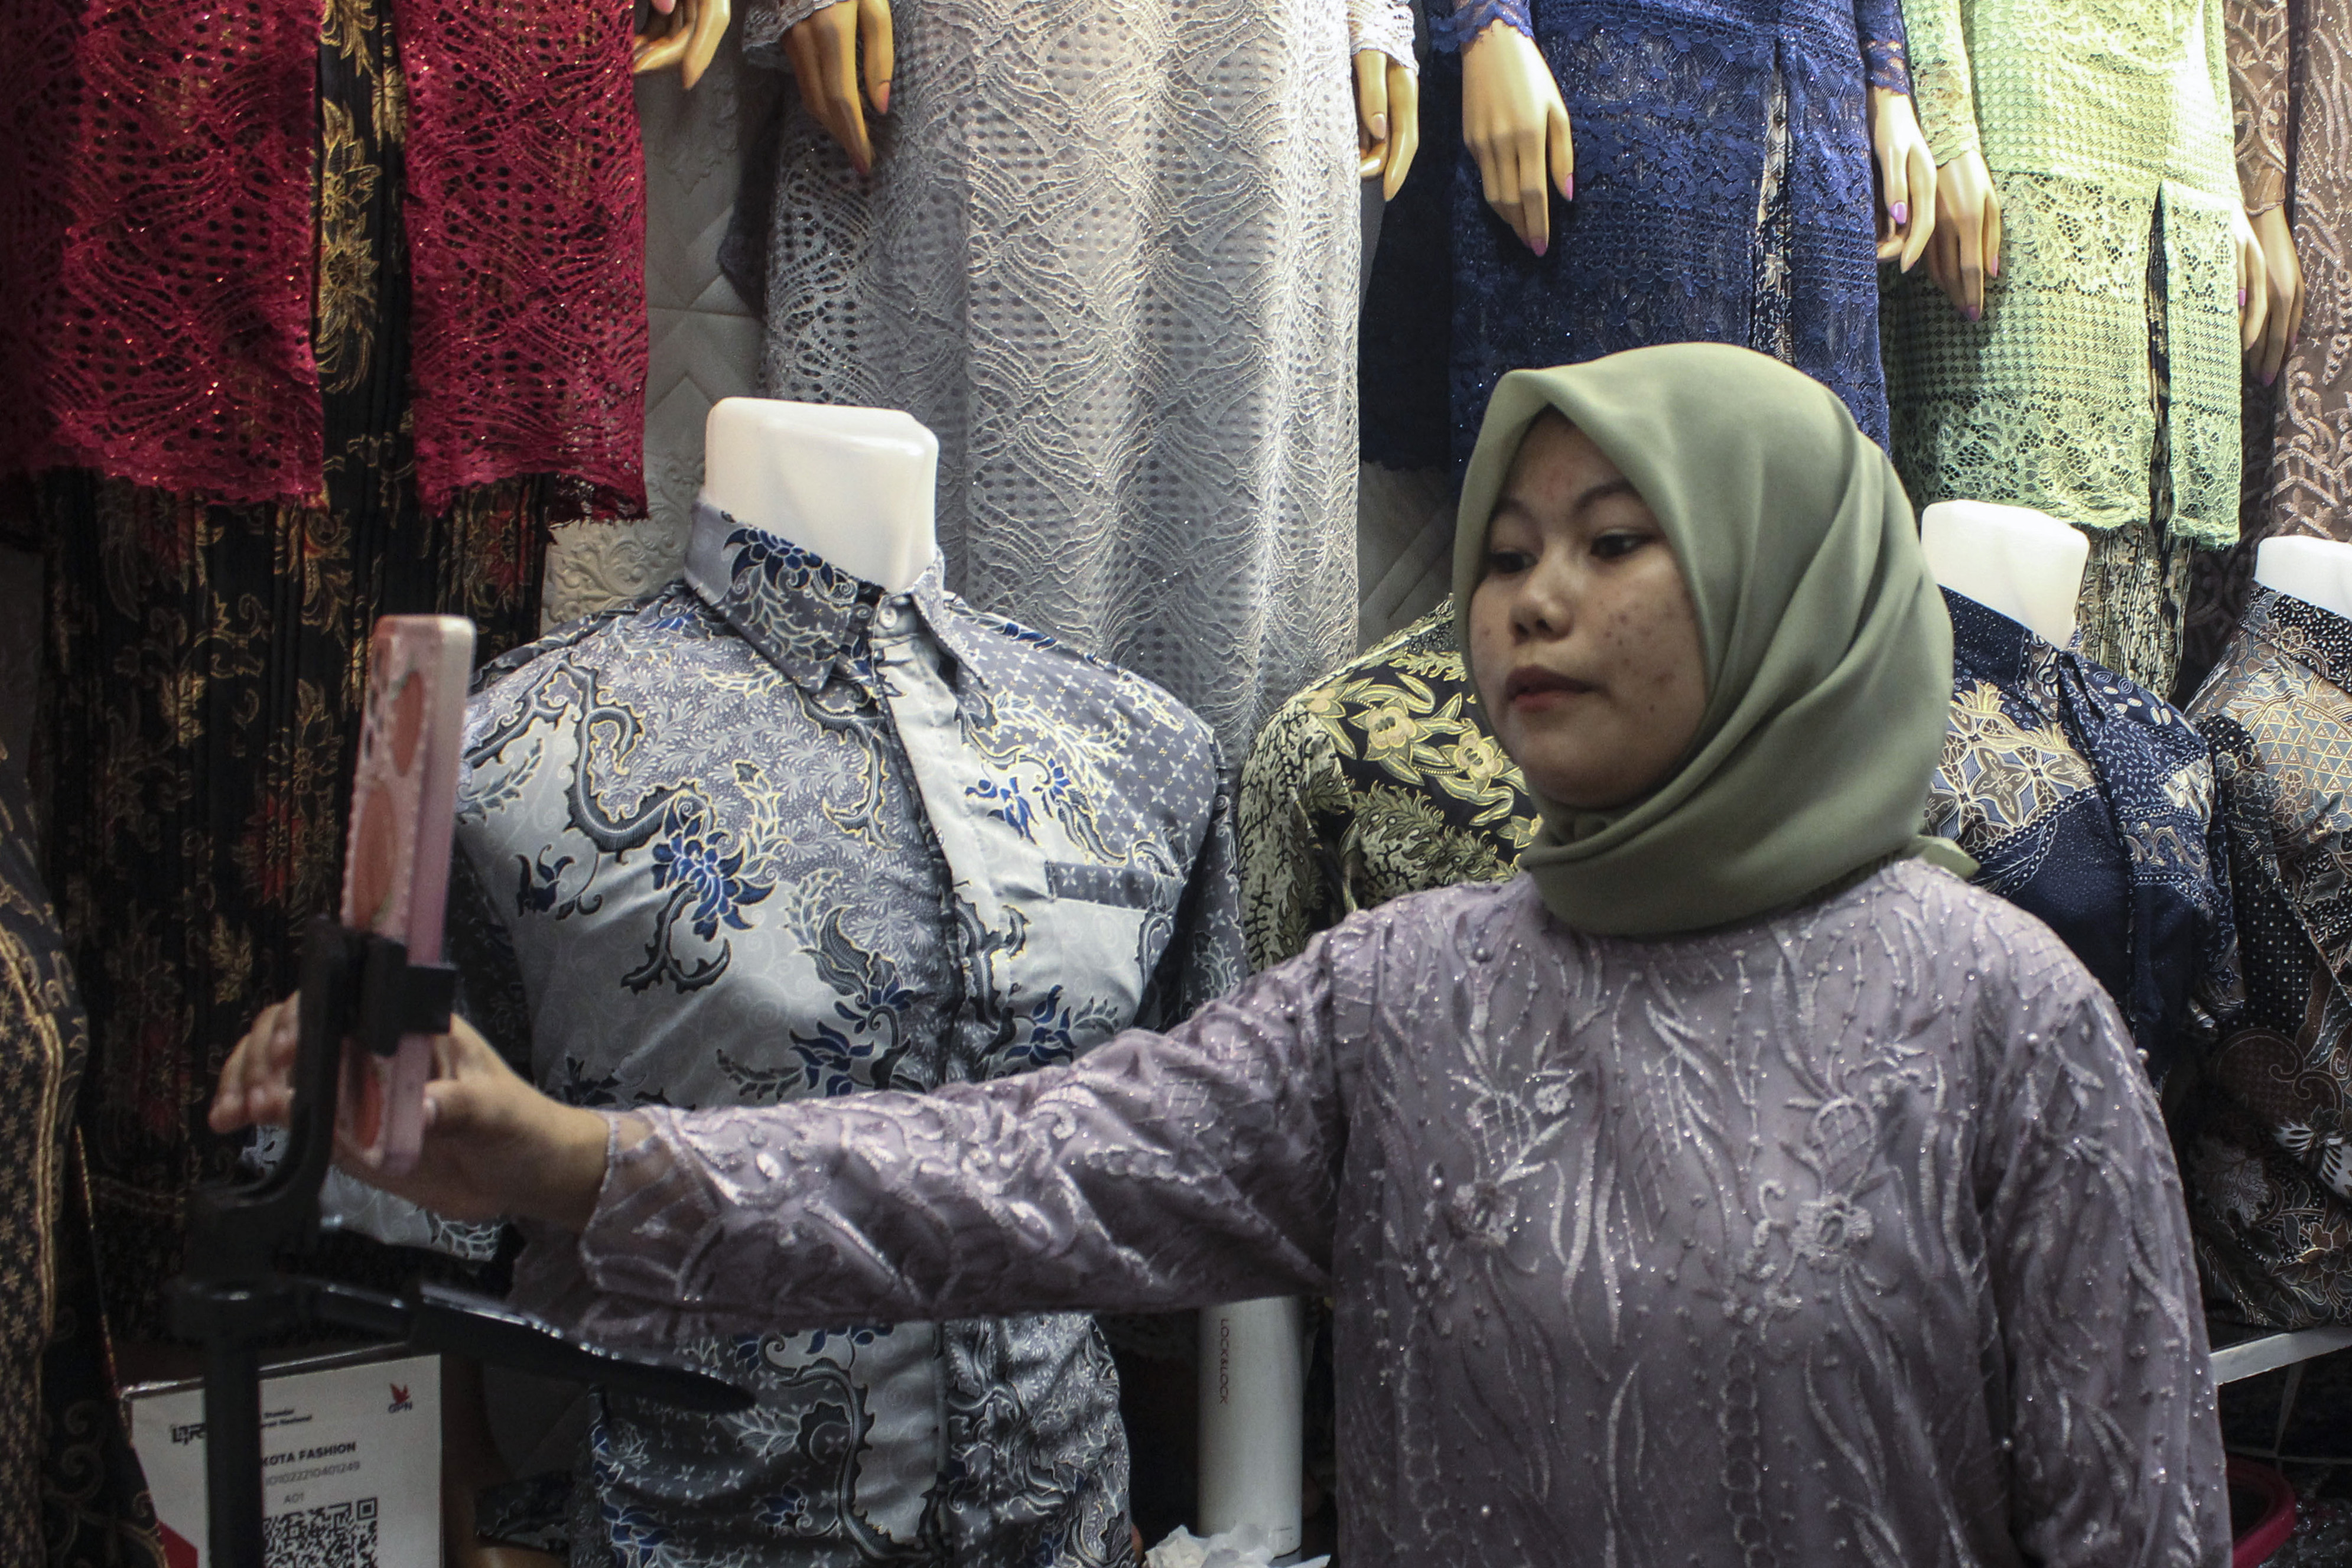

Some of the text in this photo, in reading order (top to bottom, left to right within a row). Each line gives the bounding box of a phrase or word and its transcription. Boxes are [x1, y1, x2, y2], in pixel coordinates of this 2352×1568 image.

[1219, 1318, 1229, 1404] LOCK&LOCK
[388, 1401, 413, 1413] GPN
[298, 1442, 356, 1460] FASHION
